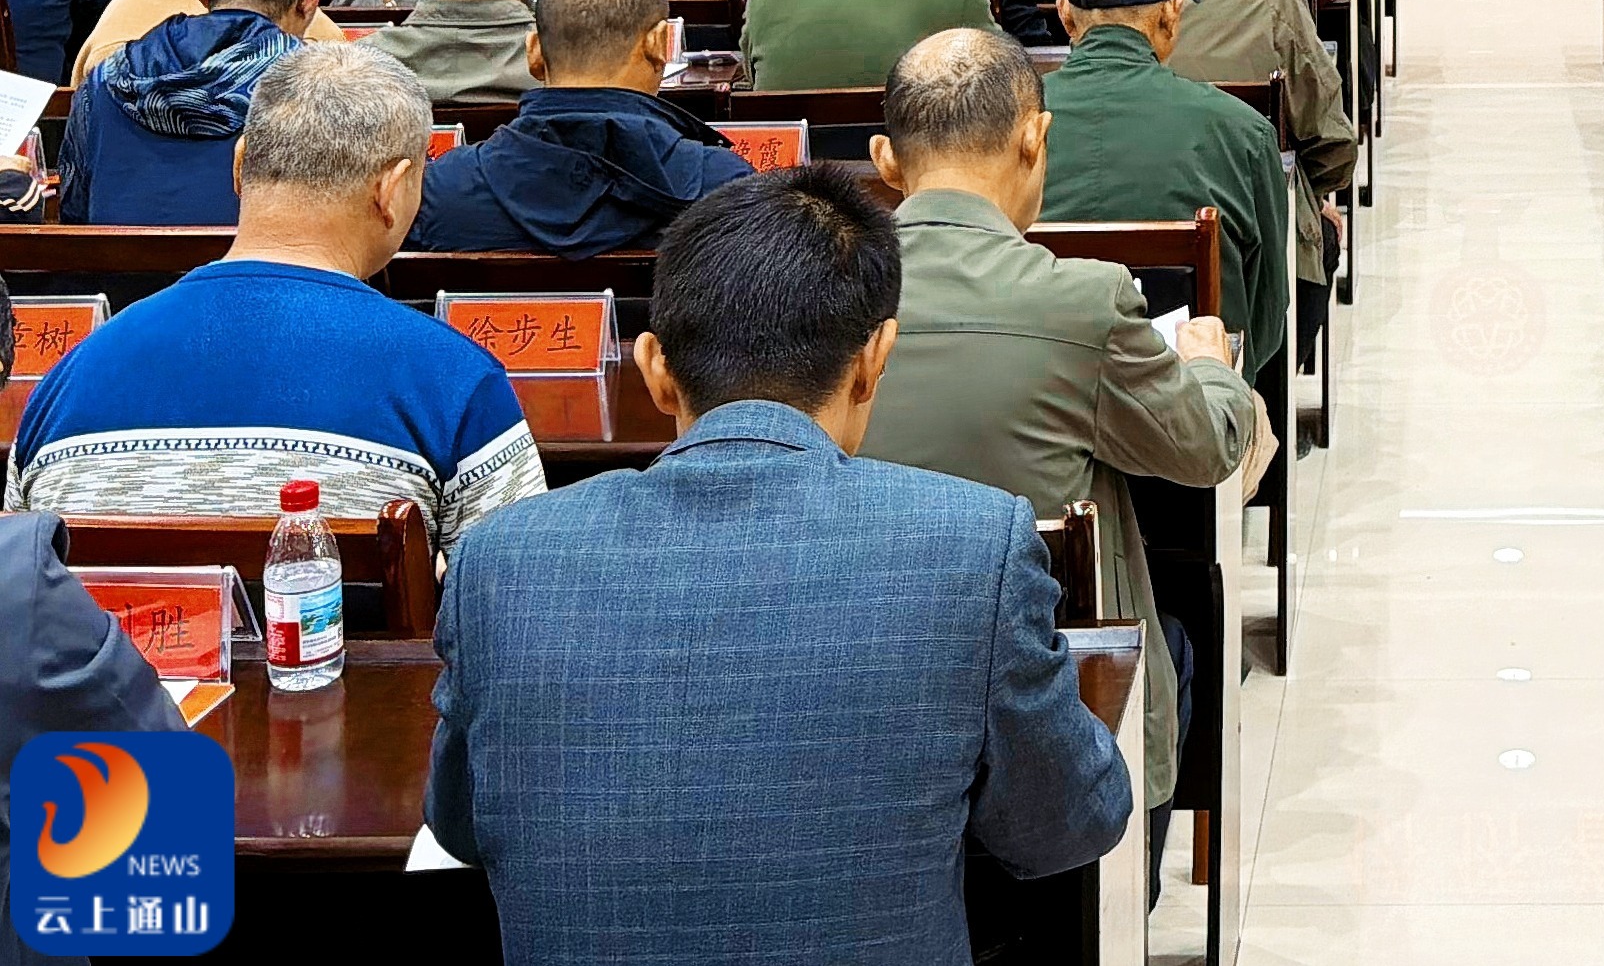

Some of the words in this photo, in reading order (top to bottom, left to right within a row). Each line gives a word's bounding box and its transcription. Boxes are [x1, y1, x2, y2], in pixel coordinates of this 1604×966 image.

[467, 313, 583, 356] 徐步生
[109, 603, 195, 655] 胜
